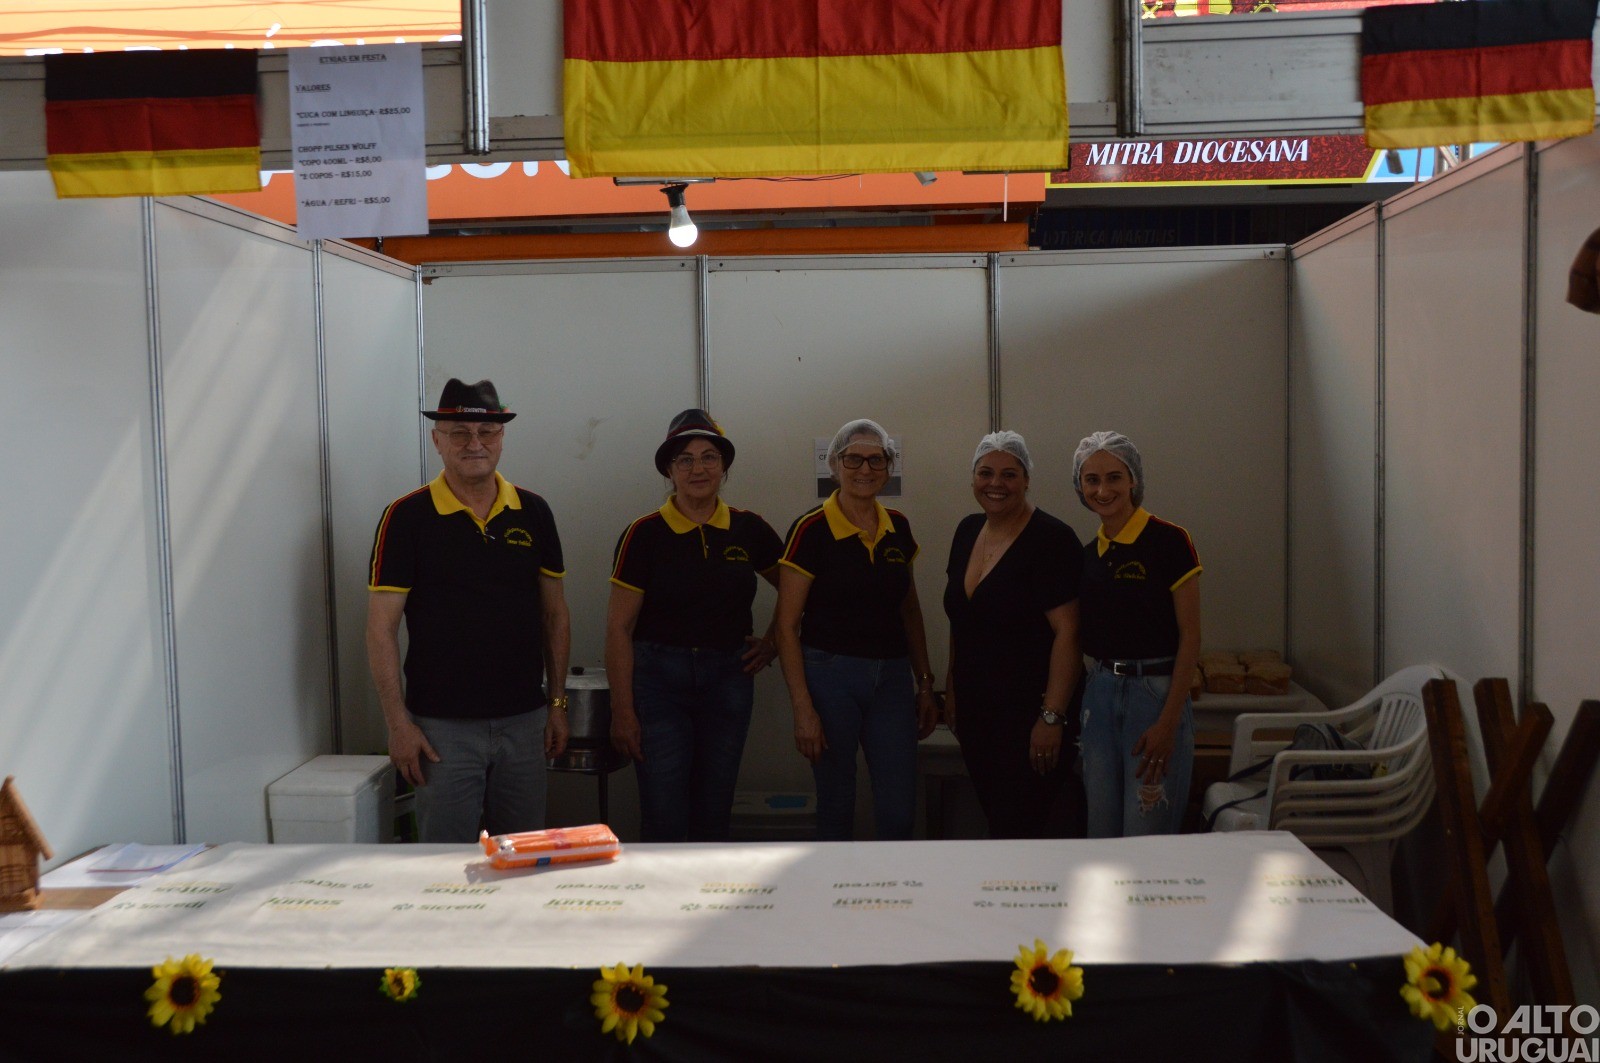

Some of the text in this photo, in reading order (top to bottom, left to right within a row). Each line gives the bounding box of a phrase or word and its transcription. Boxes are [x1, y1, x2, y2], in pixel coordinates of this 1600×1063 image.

[319, 53, 387, 64] ETNIAS EM FESTA
[295, 83, 331, 92] VALORES
[321, 110, 338, 118] COM
[297, 142, 377, 153] CHOPP PILSEN WOLFF
[1085, 139, 1308, 166] MITRA DIOCESANA
[309, 172, 334, 180] COPOS
[340, 169, 372, 178] R$15,00
[334, 198, 357, 206] REFRI
